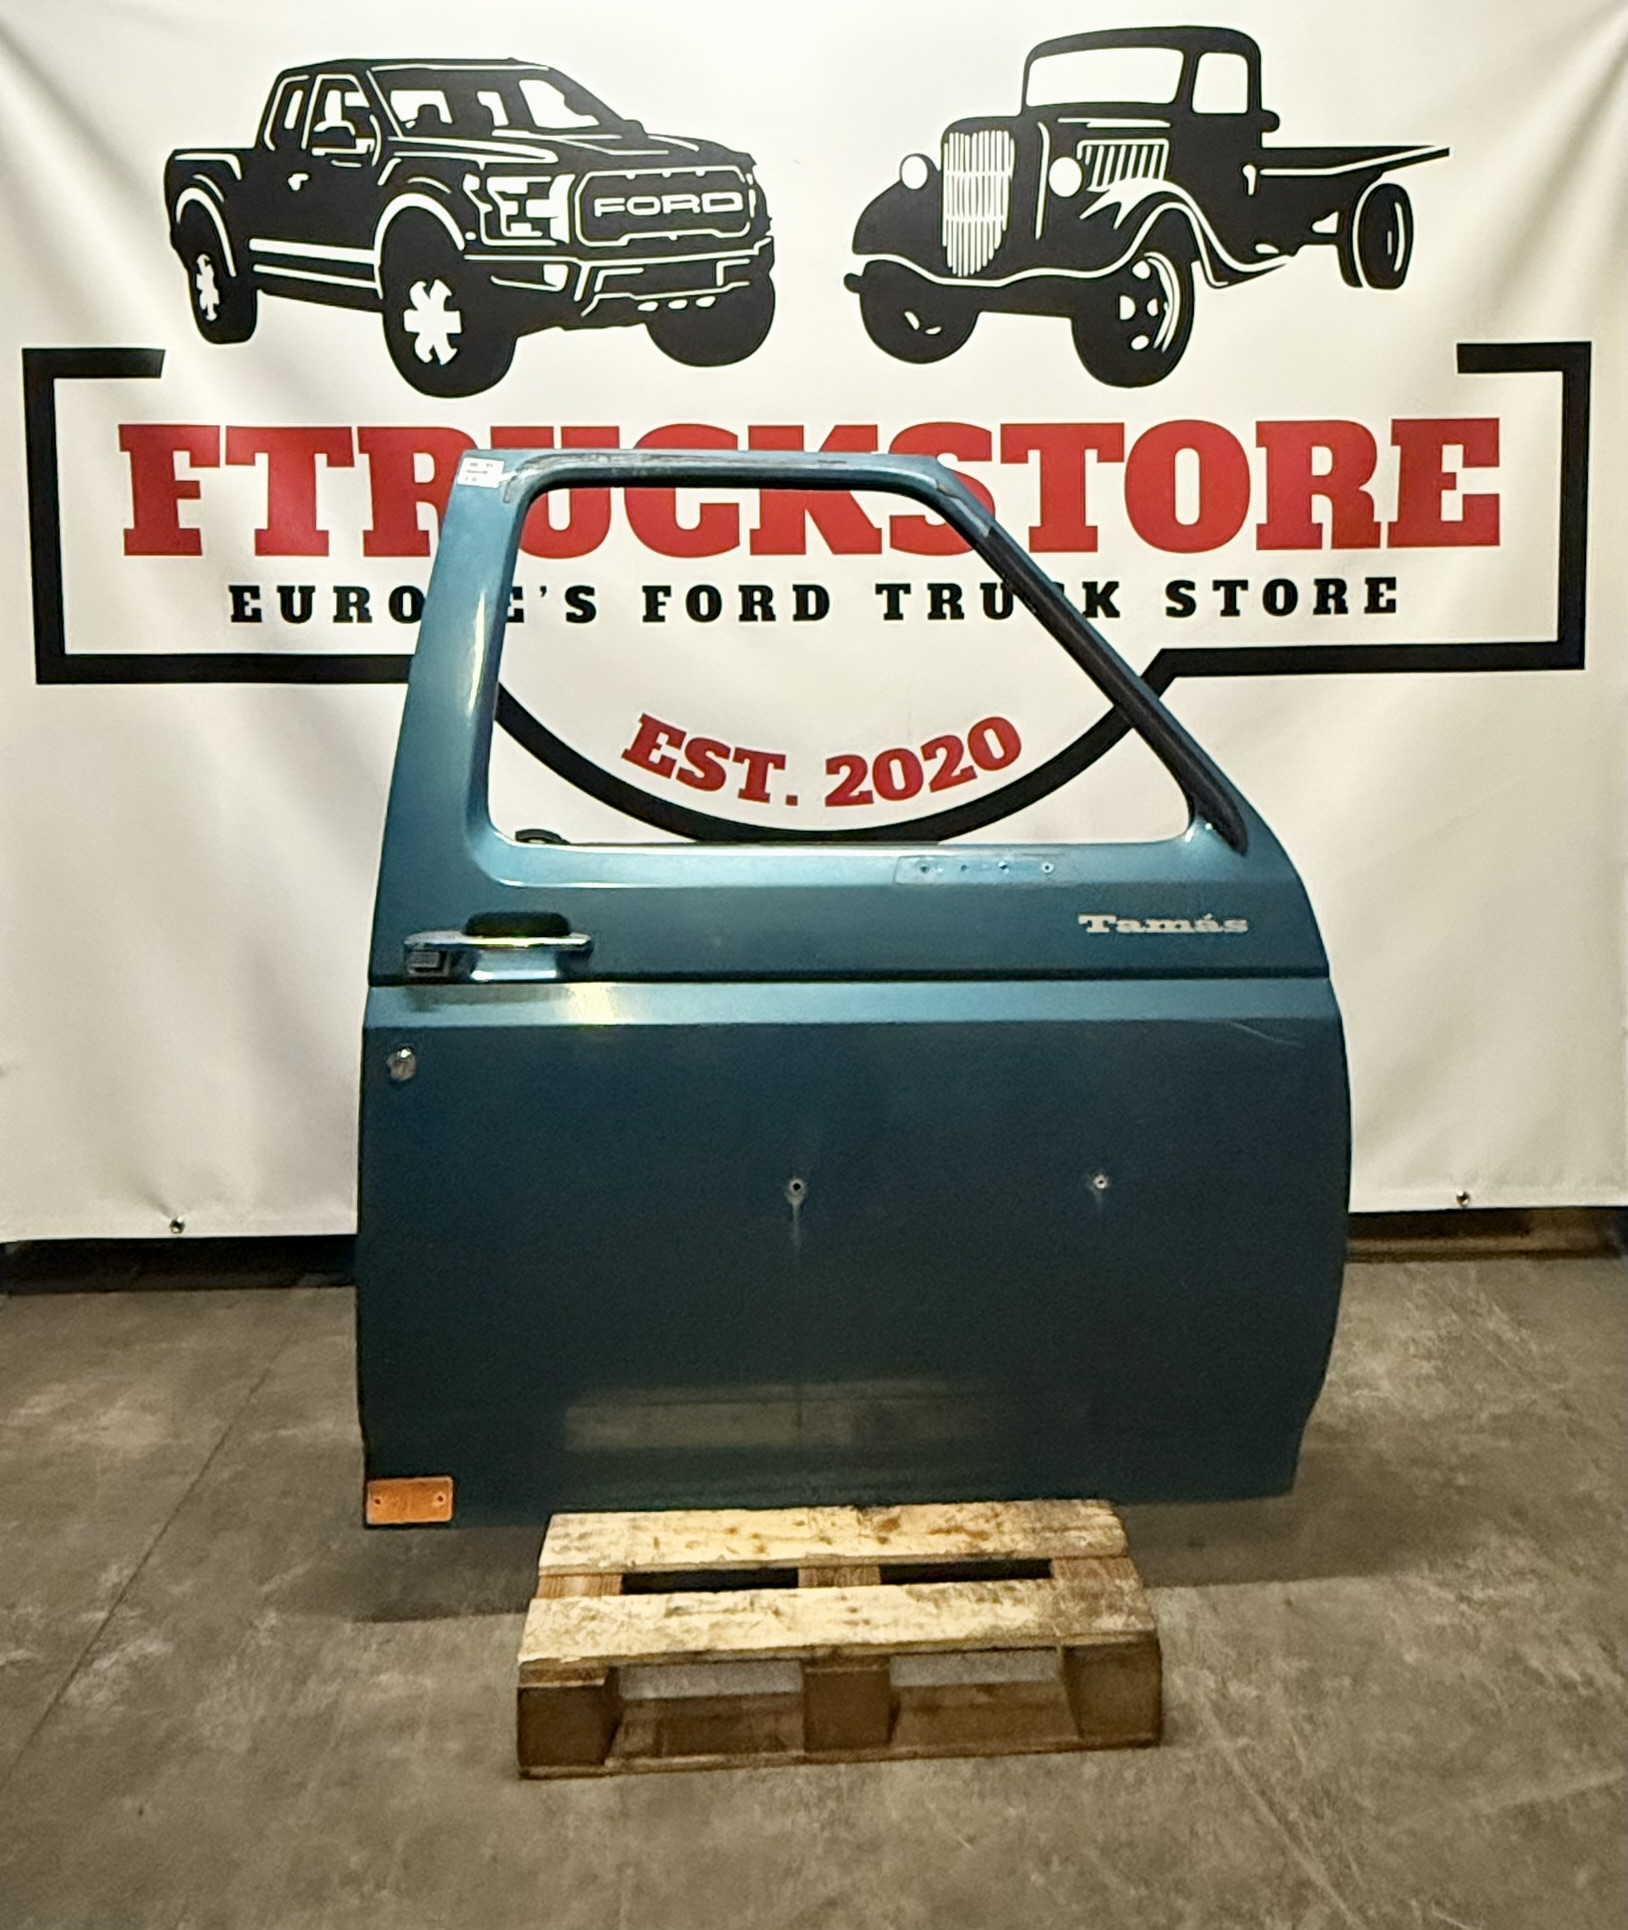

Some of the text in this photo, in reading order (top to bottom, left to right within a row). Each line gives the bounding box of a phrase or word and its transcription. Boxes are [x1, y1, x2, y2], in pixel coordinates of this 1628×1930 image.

[594, 191, 744, 218] FORD
[119, 418, 1500, 559] FTRUCKSTORE
[643, 584, 830, 623] FORD
[875, 581, 1121, 621] TRUK
[1165, 577, 1397, 618] STORE
[621, 713, 1022, 807] EST. 2020
